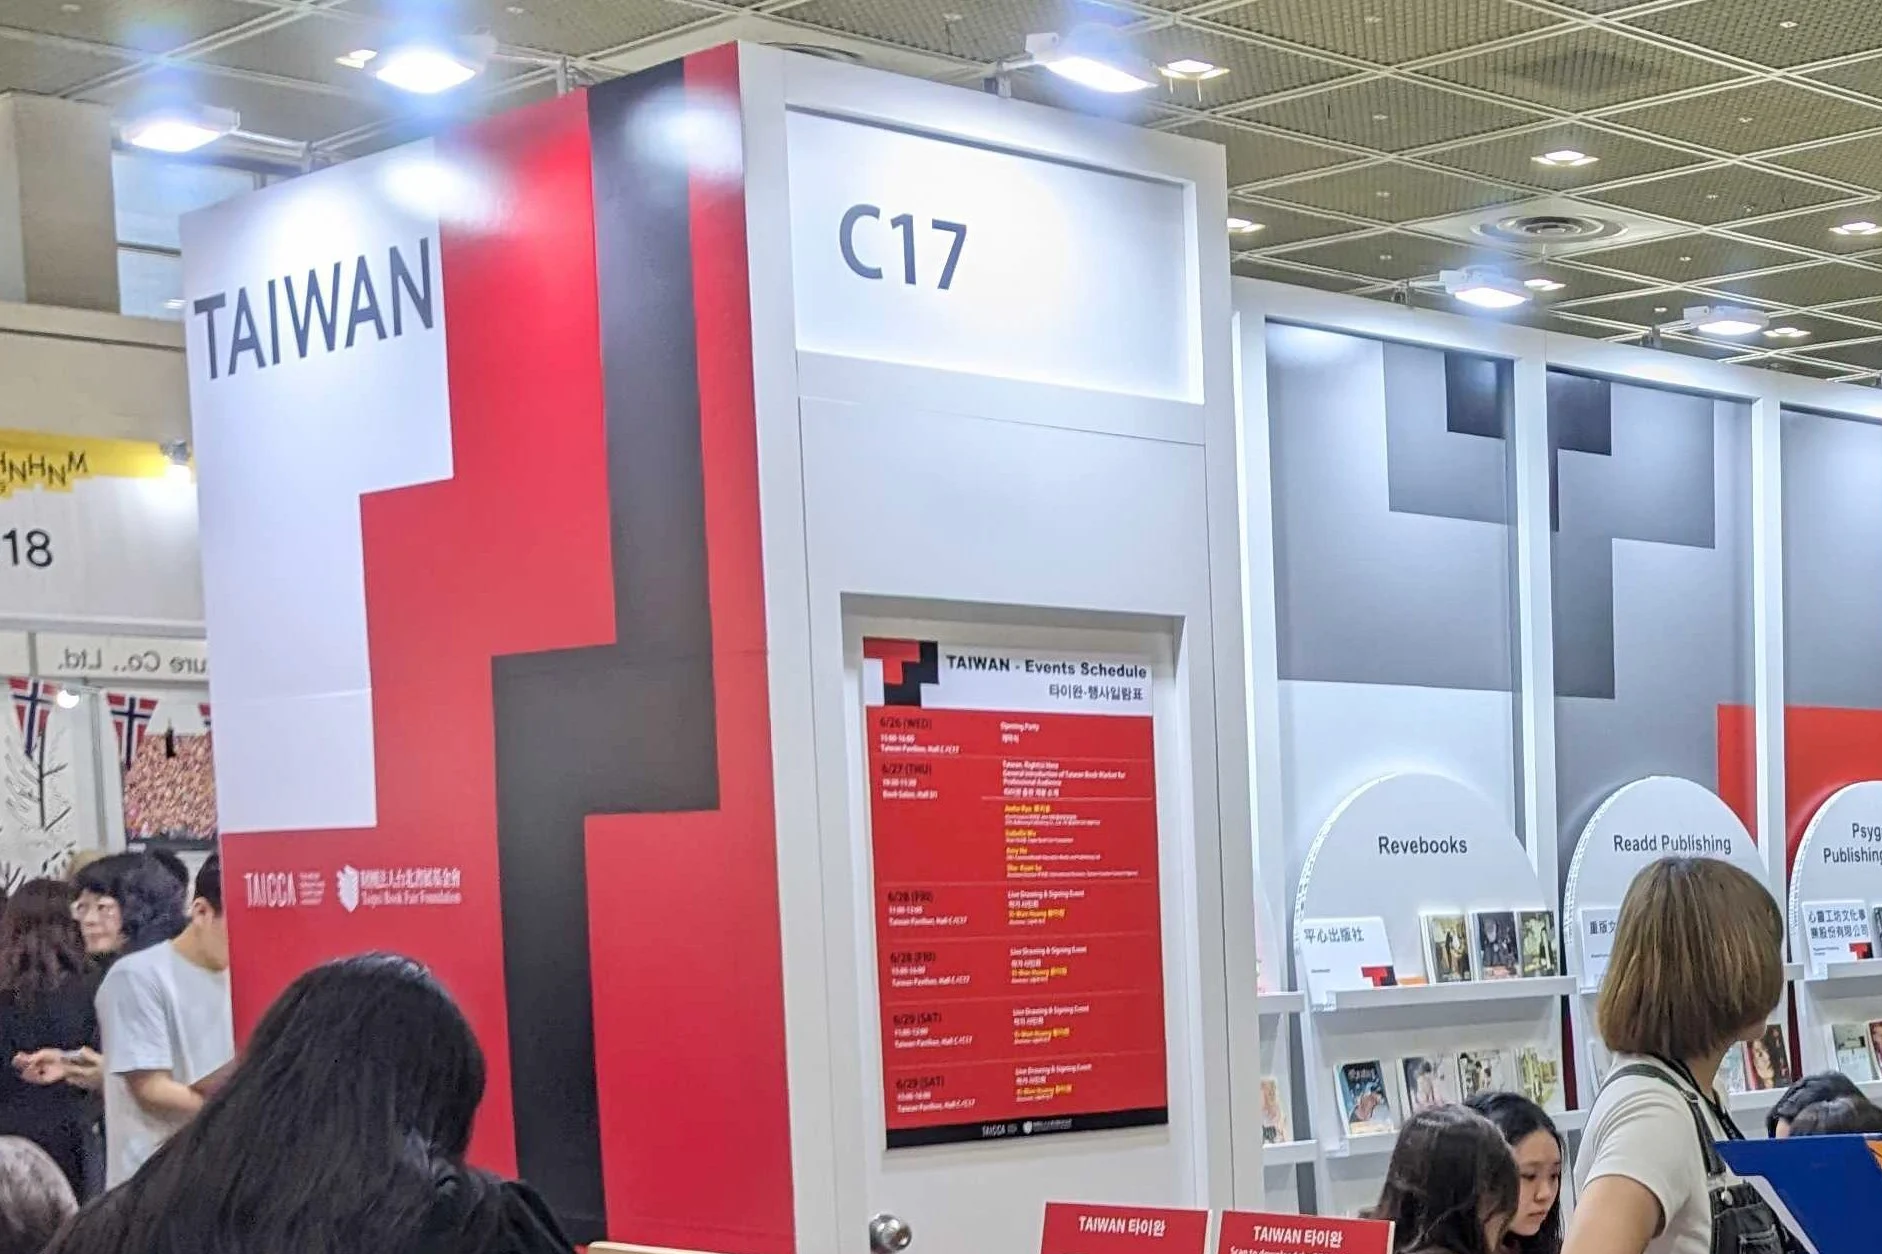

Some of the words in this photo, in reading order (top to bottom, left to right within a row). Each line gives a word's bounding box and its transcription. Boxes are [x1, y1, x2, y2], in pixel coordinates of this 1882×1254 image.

[839, 204, 967, 290] C17
[194, 237, 434, 380] TAIWAN
[946, 655, 1009, 672] TAIWAN
[1025, 660, 1075, 675] Events
[1081, 662, 1147, 679] Schedule
[1378, 835, 1468, 855] Revebooks
[1613, 835, 1657, 851] Readd
[1661, 835, 1731, 855] Publishing
[244, 871, 297, 908] TAICCA
[1078, 1215, 1125, 1234] TAIWAN
[1128, 1218, 1166, 1237] 타이완
[1253, 1225, 1301, 1244] TAIWAN
[1304, 1228, 1344, 1249] 타이완
